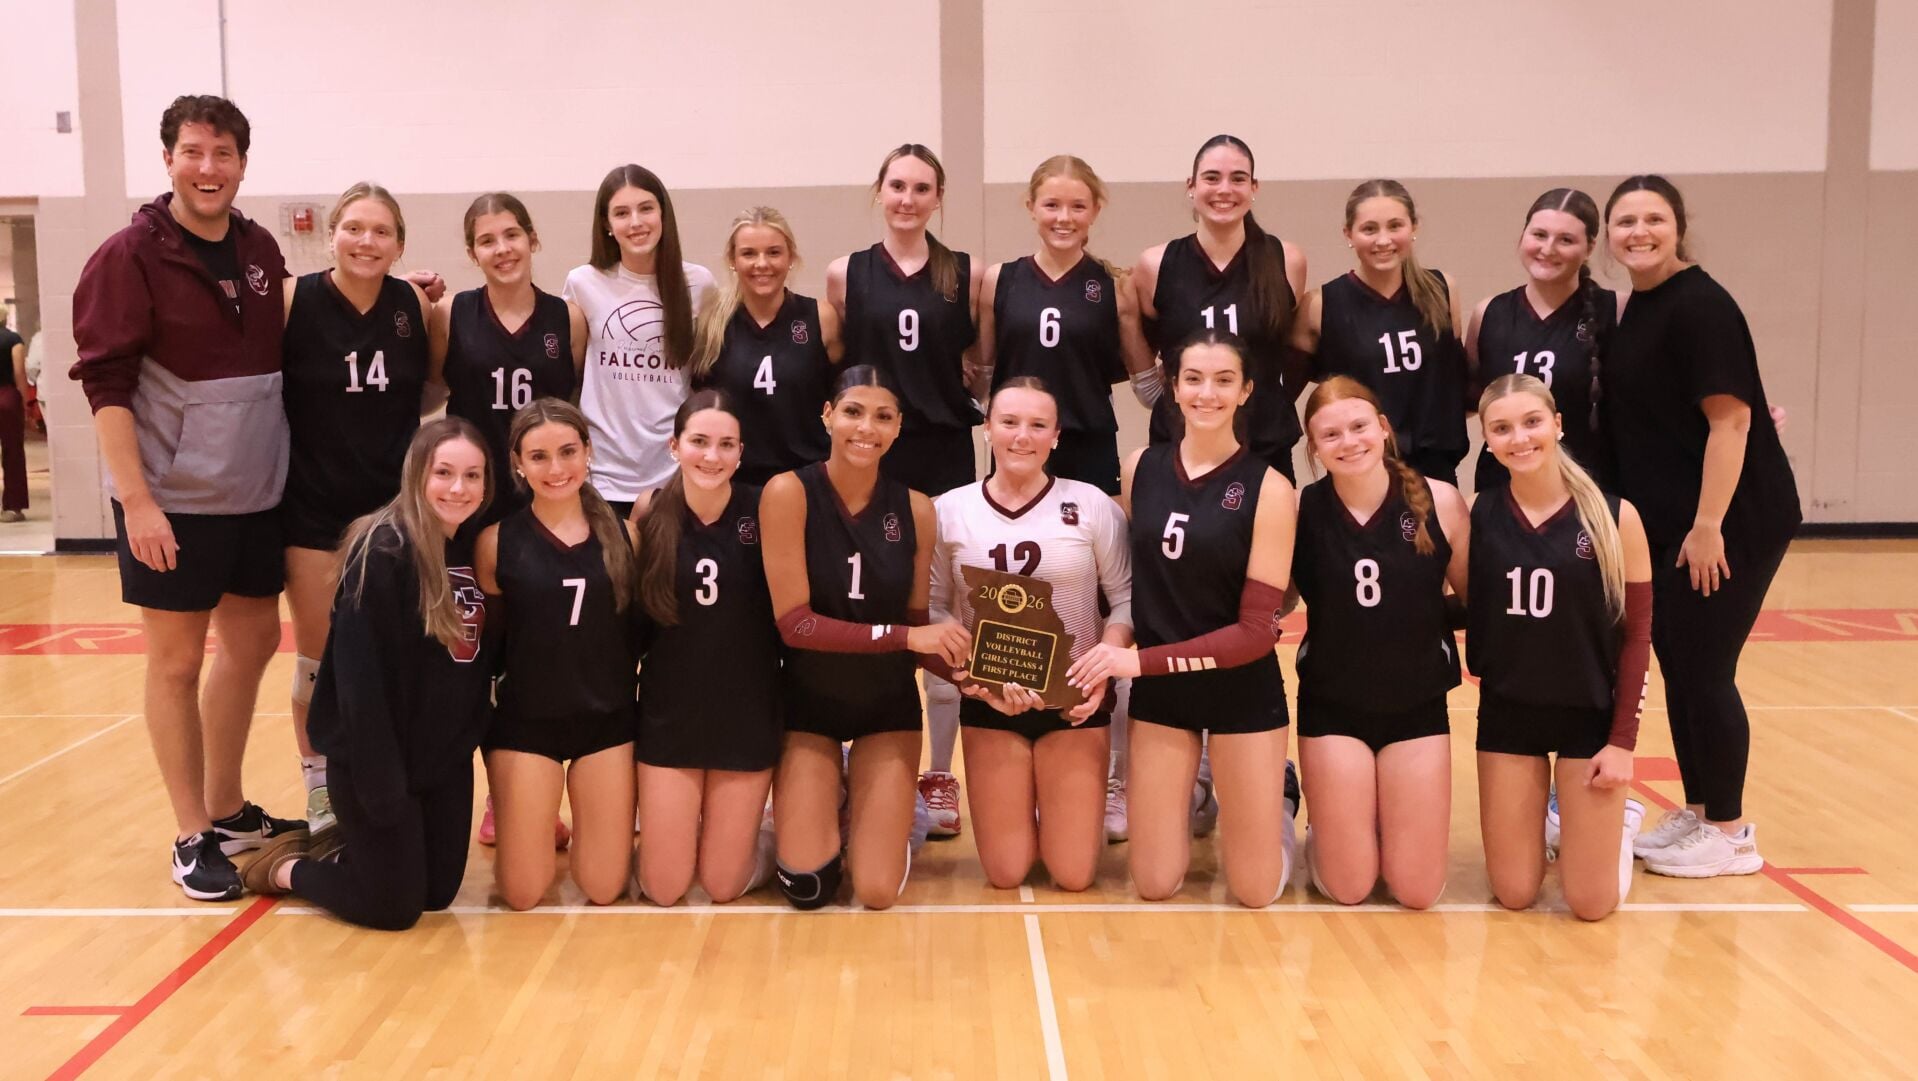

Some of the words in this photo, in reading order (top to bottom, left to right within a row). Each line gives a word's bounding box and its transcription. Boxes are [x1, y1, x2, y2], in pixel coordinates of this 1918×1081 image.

[898, 308, 919, 352] 9
[1039, 307, 1061, 348] 6
[1200, 303, 1238, 337] 11
[344, 350, 390, 392] 14
[1378, 329, 1422, 374] 15
[1513, 350, 1556, 391] 13
[491, 366, 533, 411] 16
[612, 371, 674, 384] VOLLEYBALL
[753, 355, 777, 395] 4
[1161, 511, 1190, 560] 5
[847, 552, 865, 600] 1
[988, 540, 1042, 577] 12
[562, 578, 586, 626] 7
[695, 558, 719, 606] 3
[979, 585, 998, 600] 20
[1026, 594, 1045, 610] 26
[1354, 558, 1382, 608] 8
[1506, 566, 1554, 618] 10
[985, 641, 1044, 660] VOLLEYBALL
[996, 631, 1038, 647] DISTRICT
[981, 652, 1008, 664] GIRLS
[1009, 659, 1037, 670] CLASS
[982, 664, 1008, 676] FIRST
[1008, 670, 1038, 682] PLACE
